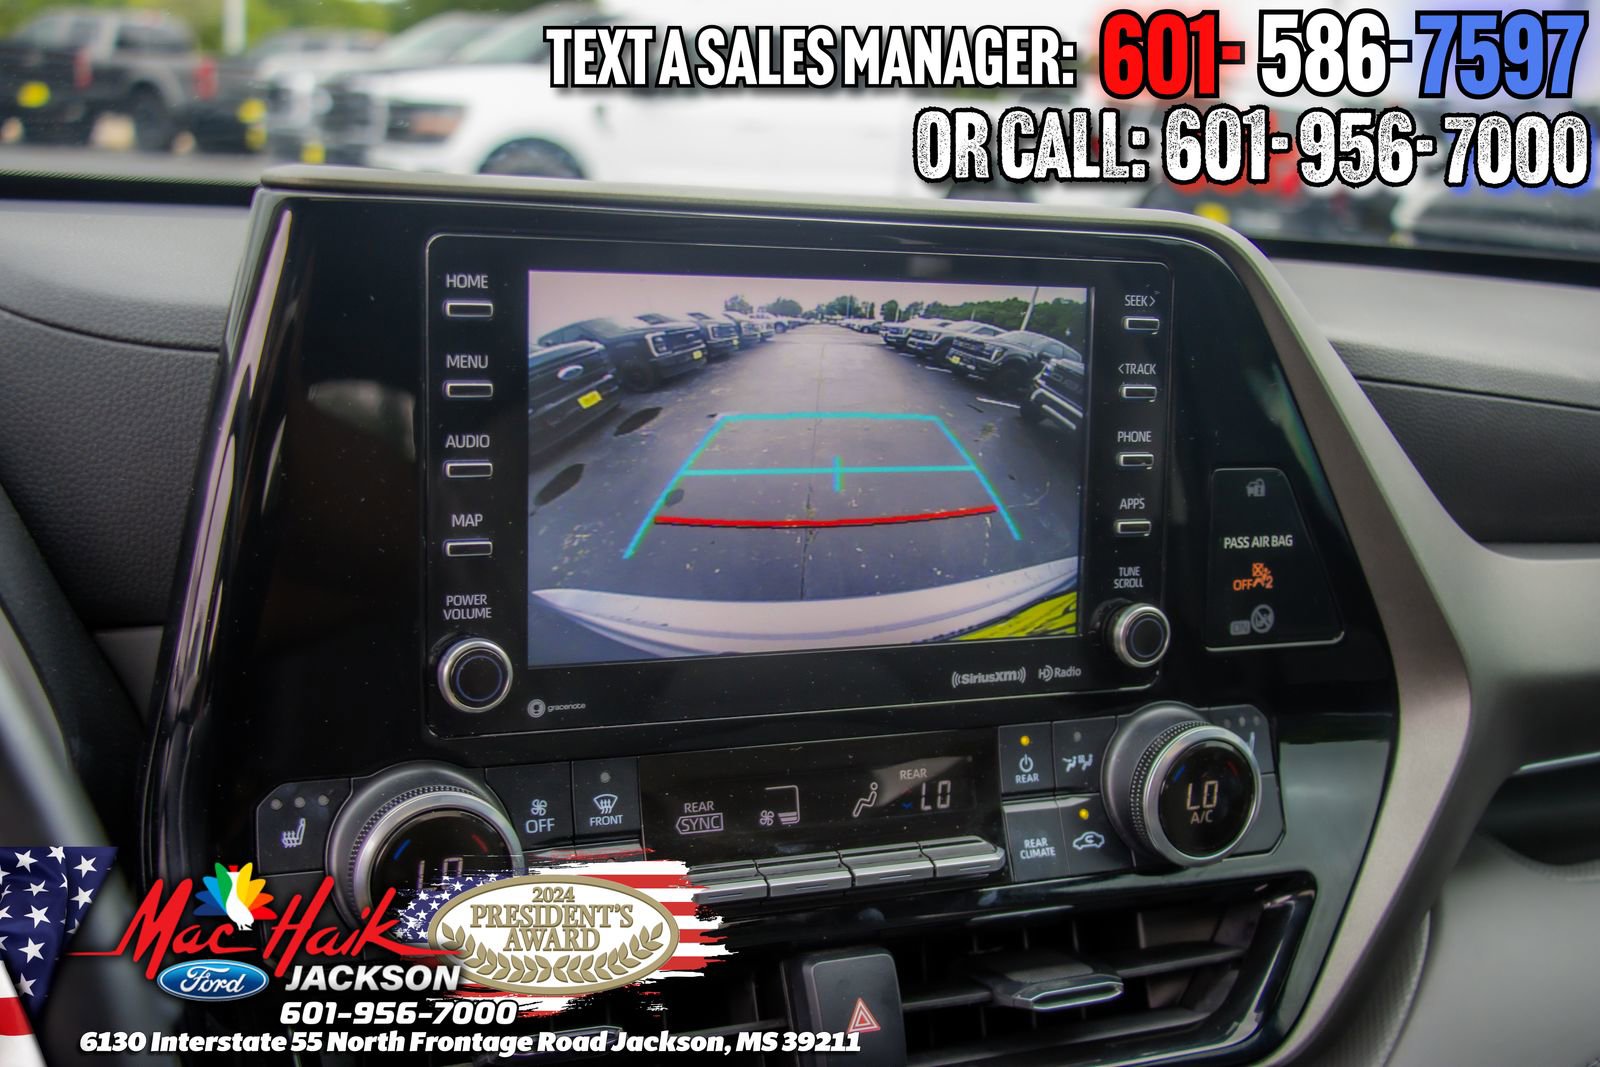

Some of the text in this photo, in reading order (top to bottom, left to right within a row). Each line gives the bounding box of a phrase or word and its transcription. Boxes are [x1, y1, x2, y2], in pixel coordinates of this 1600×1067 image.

[445, 274, 489, 289] HOME
[445, 354, 489, 369] MENU
[445, 434, 490, 448] AUDIO
[1117, 430, 1152, 443] PHONE
[1119, 497, 1146, 510] APPS
[451, 513, 484, 528] MAP
[1223, 534, 1294, 549] PASS AIR BAG
[1118, 566, 1141, 577] TUNE
[1113, 576, 1144, 589] SCROLL
[1232, 578, 1253, 591] OFF
[445, 594, 488, 606] POWER
[443, 607, 493, 620] VOLUME
[1054, 666, 1082, 678] Radio
[547, 702, 586, 713] gracenote
[899, 767, 928, 780] REAR
[1015, 773, 1040, 784] REAR
[920, 780, 951, 811] LO
[1187, 780, 1218, 811] LO
[684, 801, 715, 813] REAR
[589, 814, 624, 827] FRONT
[681, 815, 720, 832] SYNC
[1190, 811, 1213, 825] A/C
[525, 818, 556, 834] OFF
[1023, 838, 1049, 849] REAR
[1020, 847, 1056, 859] CLIMATE
